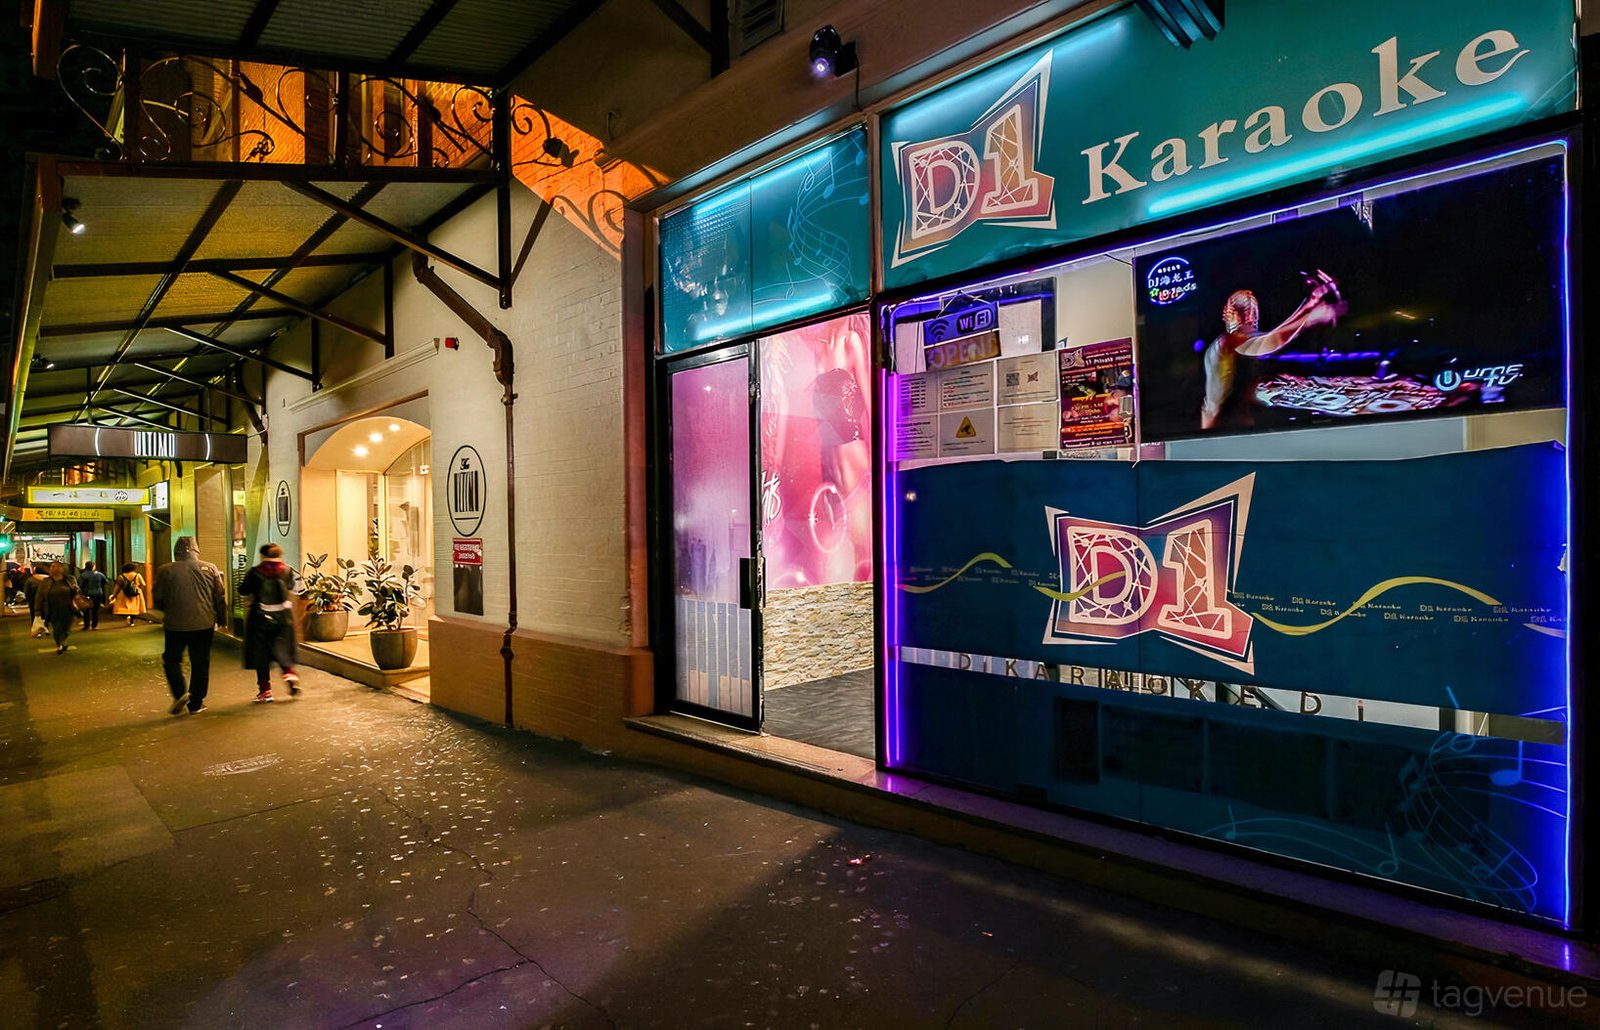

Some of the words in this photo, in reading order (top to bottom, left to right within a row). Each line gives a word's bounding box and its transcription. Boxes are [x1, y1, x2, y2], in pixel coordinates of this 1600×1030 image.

[908, 103, 1039, 241] D1
[1080, 28, 1530, 206] Karaoke
[134, 431, 176, 458] ULTIMO
[1066, 518, 1233, 641] D1
